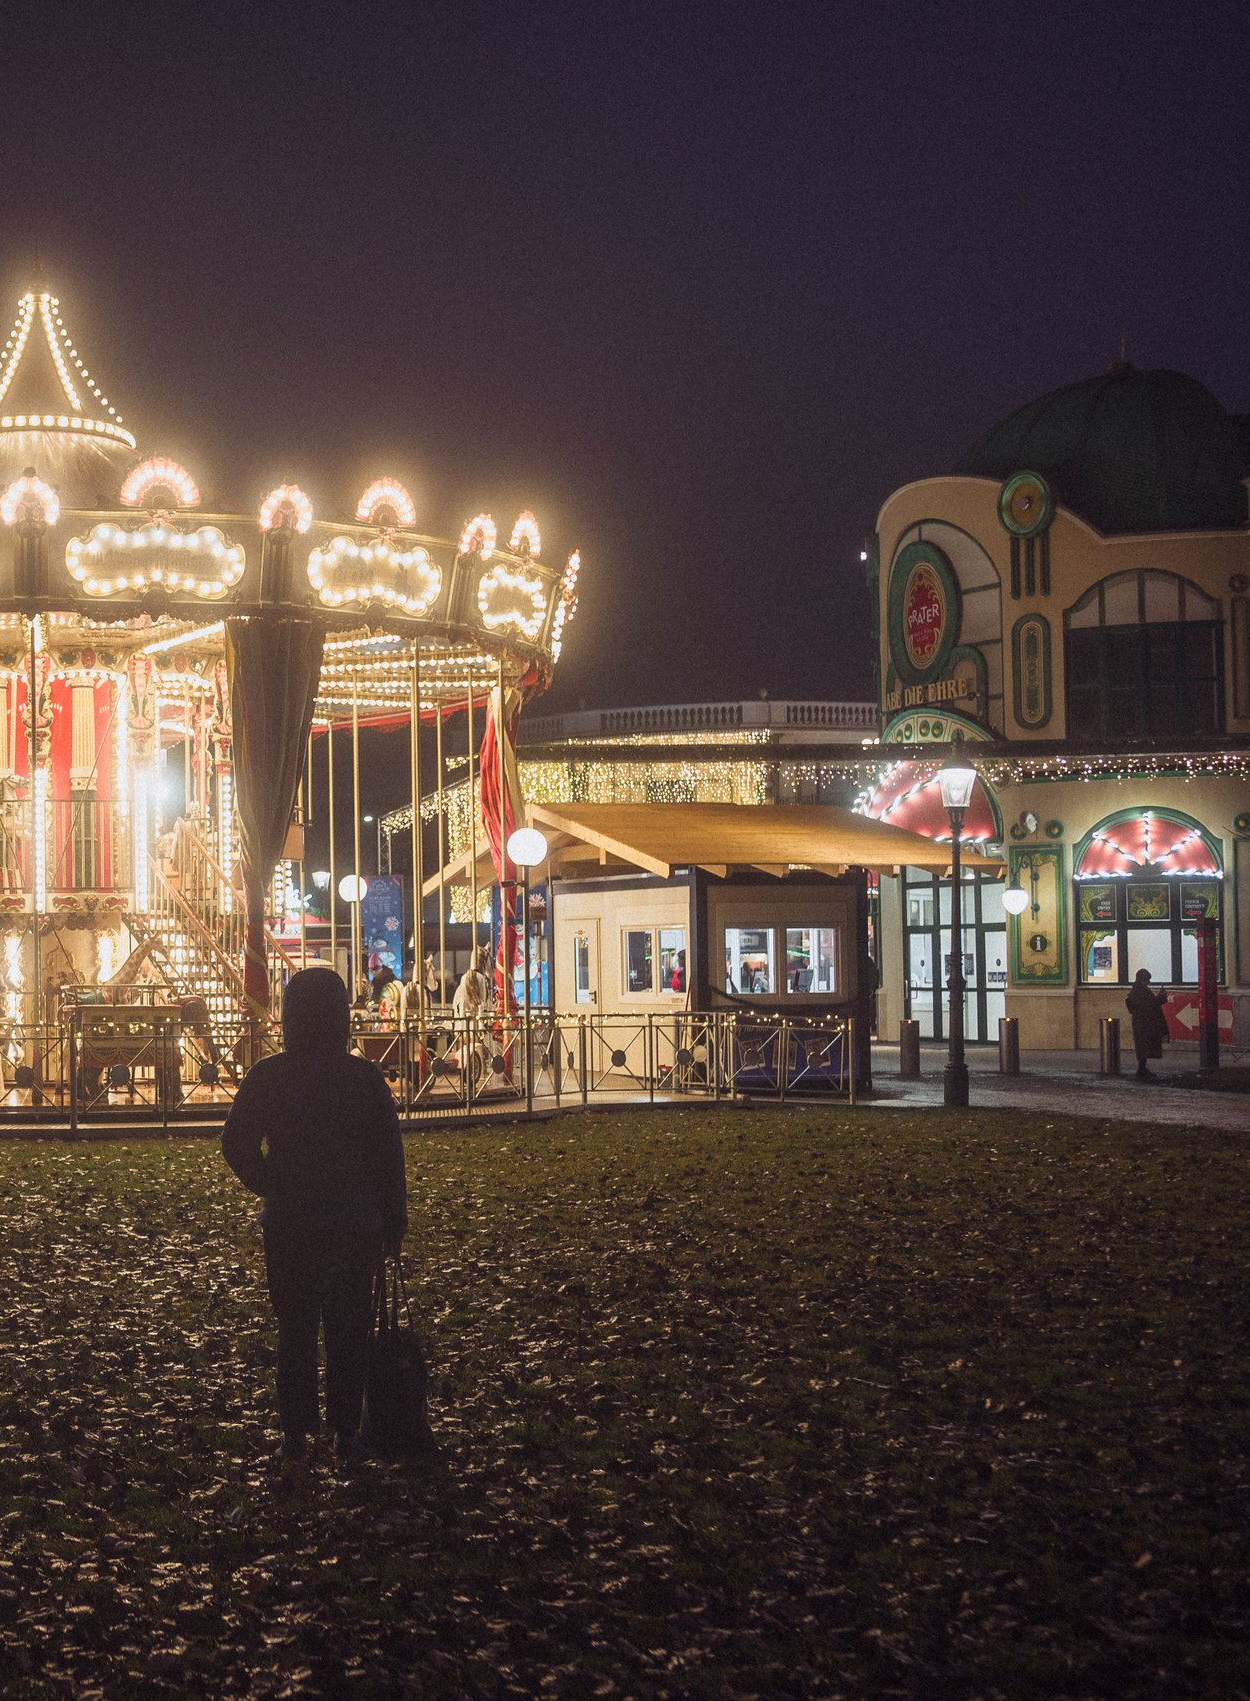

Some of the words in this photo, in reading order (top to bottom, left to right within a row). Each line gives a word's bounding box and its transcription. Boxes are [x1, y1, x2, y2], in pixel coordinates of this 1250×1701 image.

[908, 603, 940, 629] PRATER
[886, 690, 902, 712] ABE
[903, 684, 924, 706] DIE
[928, 678, 968, 703] EHRE
